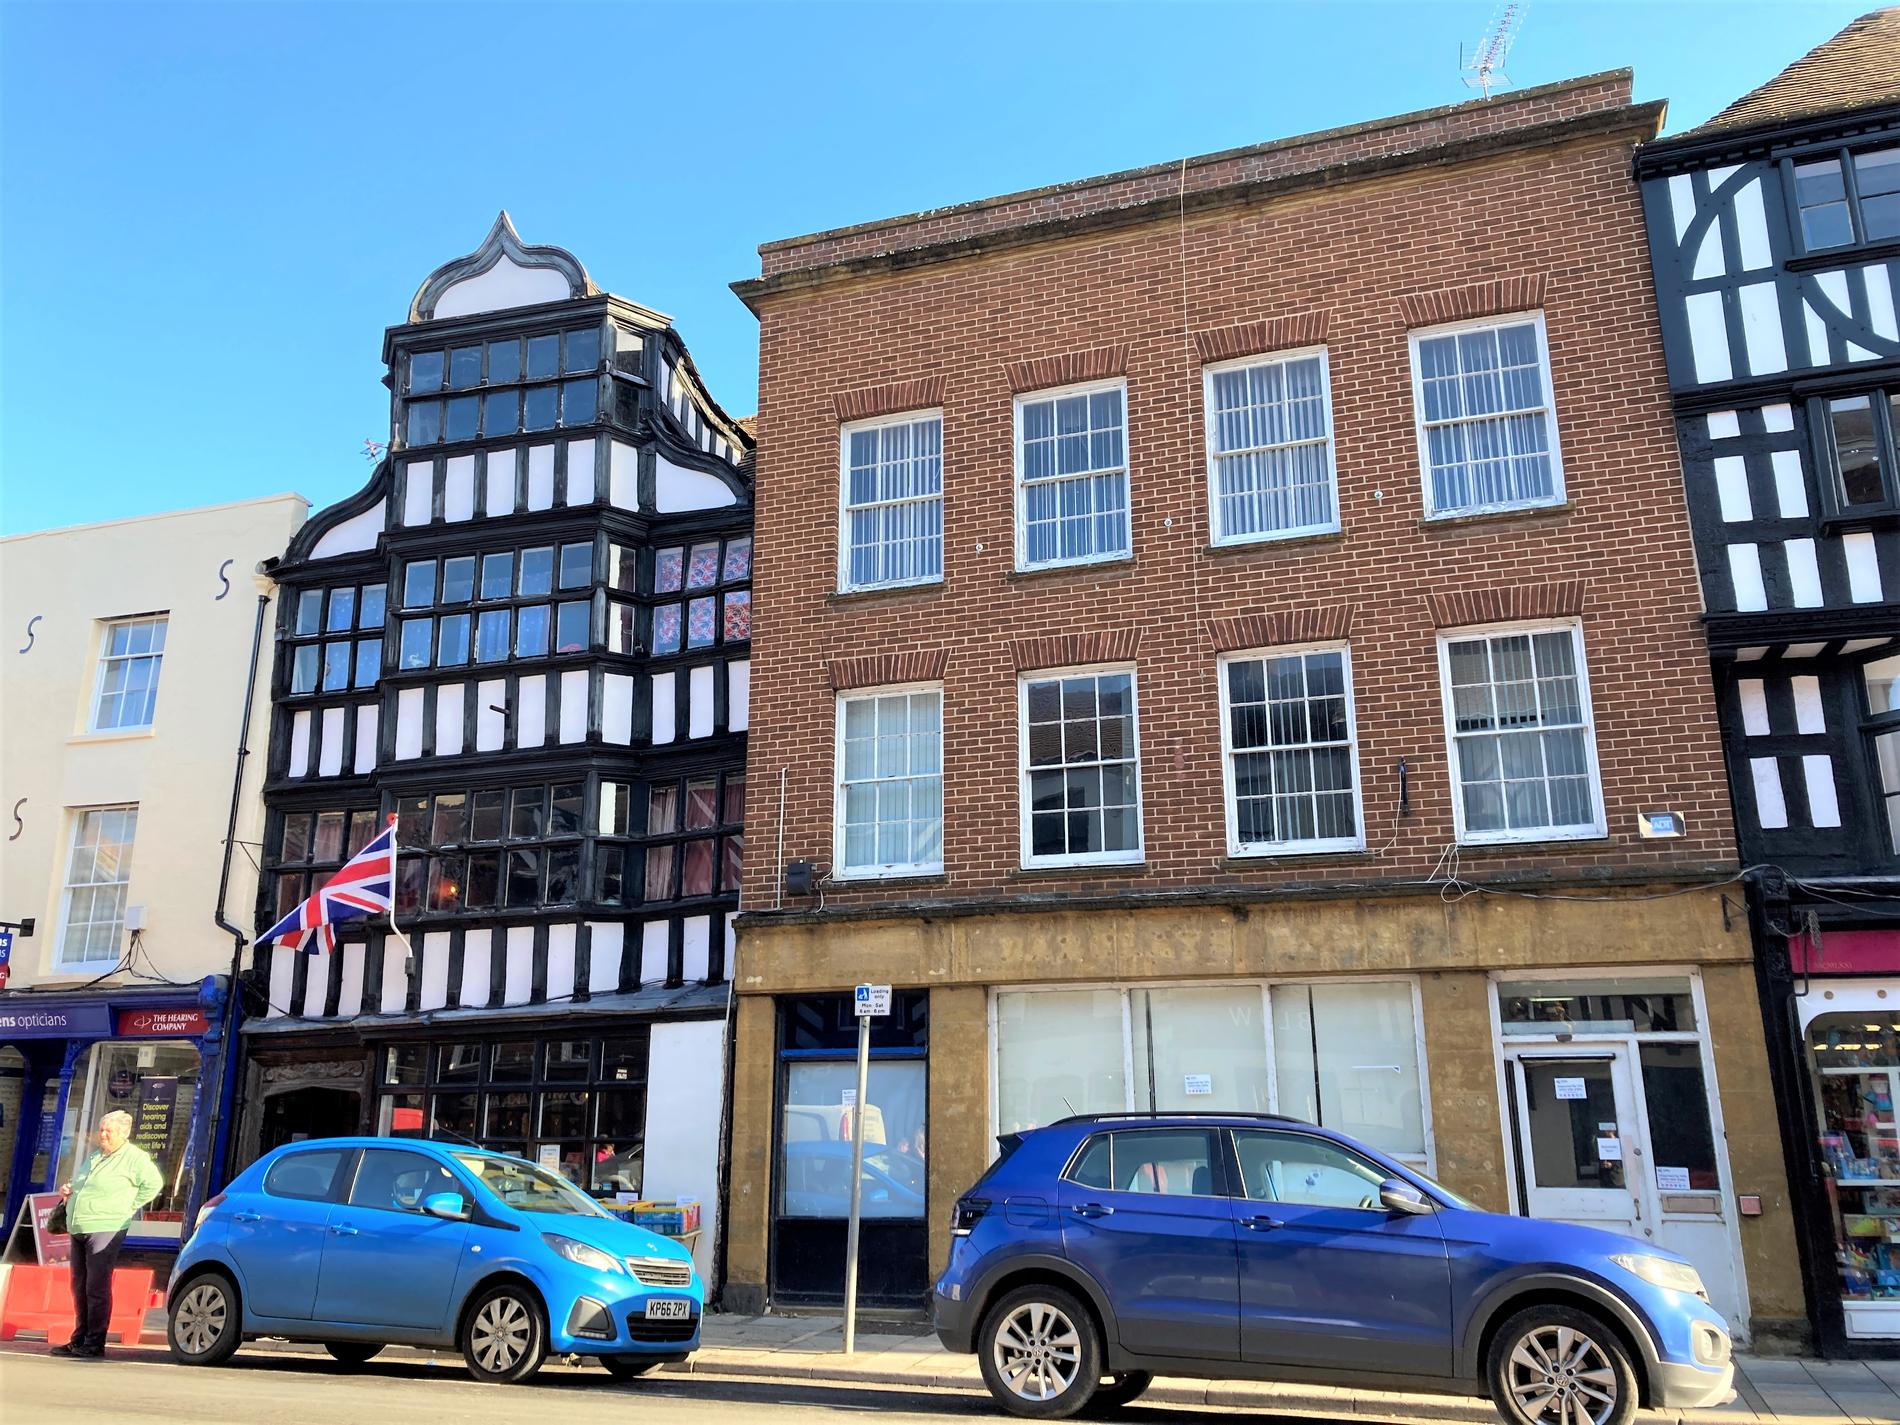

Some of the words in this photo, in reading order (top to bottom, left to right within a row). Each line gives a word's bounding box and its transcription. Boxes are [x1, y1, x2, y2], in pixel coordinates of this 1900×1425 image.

[1653, 820, 1672, 830] ADT
[17, 1013, 67, 1029] opticians
[153, 1014, 166, 1022] THE
[167, 1013, 199, 1022] HEARING
[152, 1023, 187, 1031] COMPANY
[142, 1103, 169, 1111] Discover
[142, 1113, 167, 1122] hearing
[139, 1122, 152, 1130] aids
[153, 1122, 167, 1130] and
[135, 1132, 168, 1140] rediscover
[138, 1142, 151, 1150] hat
[151, 1141, 166, 1150] life's
[650, 1301, 672, 1316] KP66
[673, 1302, 688, 1317] ZPX
